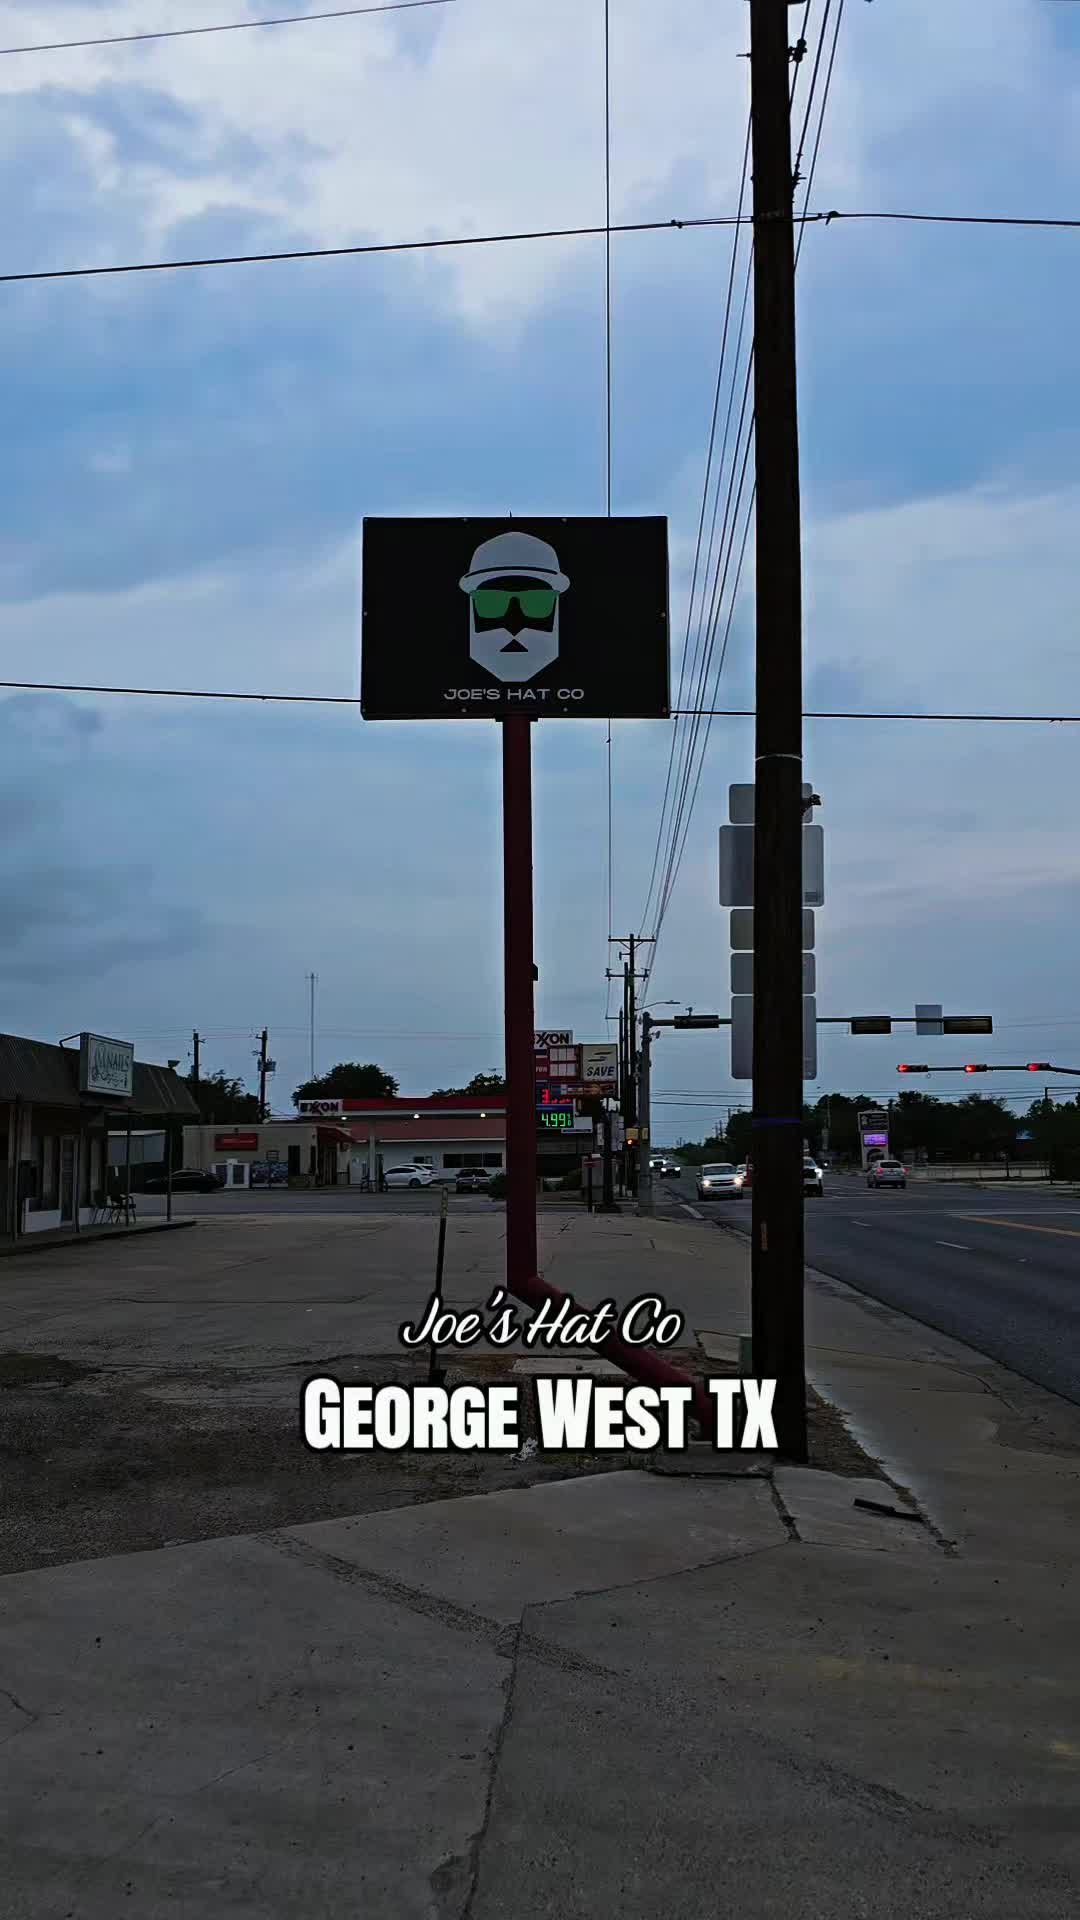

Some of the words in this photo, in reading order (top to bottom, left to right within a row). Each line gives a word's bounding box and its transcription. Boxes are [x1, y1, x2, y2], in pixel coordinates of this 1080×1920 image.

[443, 688, 501, 701] JOE'S
[507, 688, 551, 701] HAT
[557, 688, 585, 701] CO
[535, 1031, 569, 1048] XXON
[586, 1066, 614, 1076] SAVE
[300, 1101, 339, 1115] EXXON
